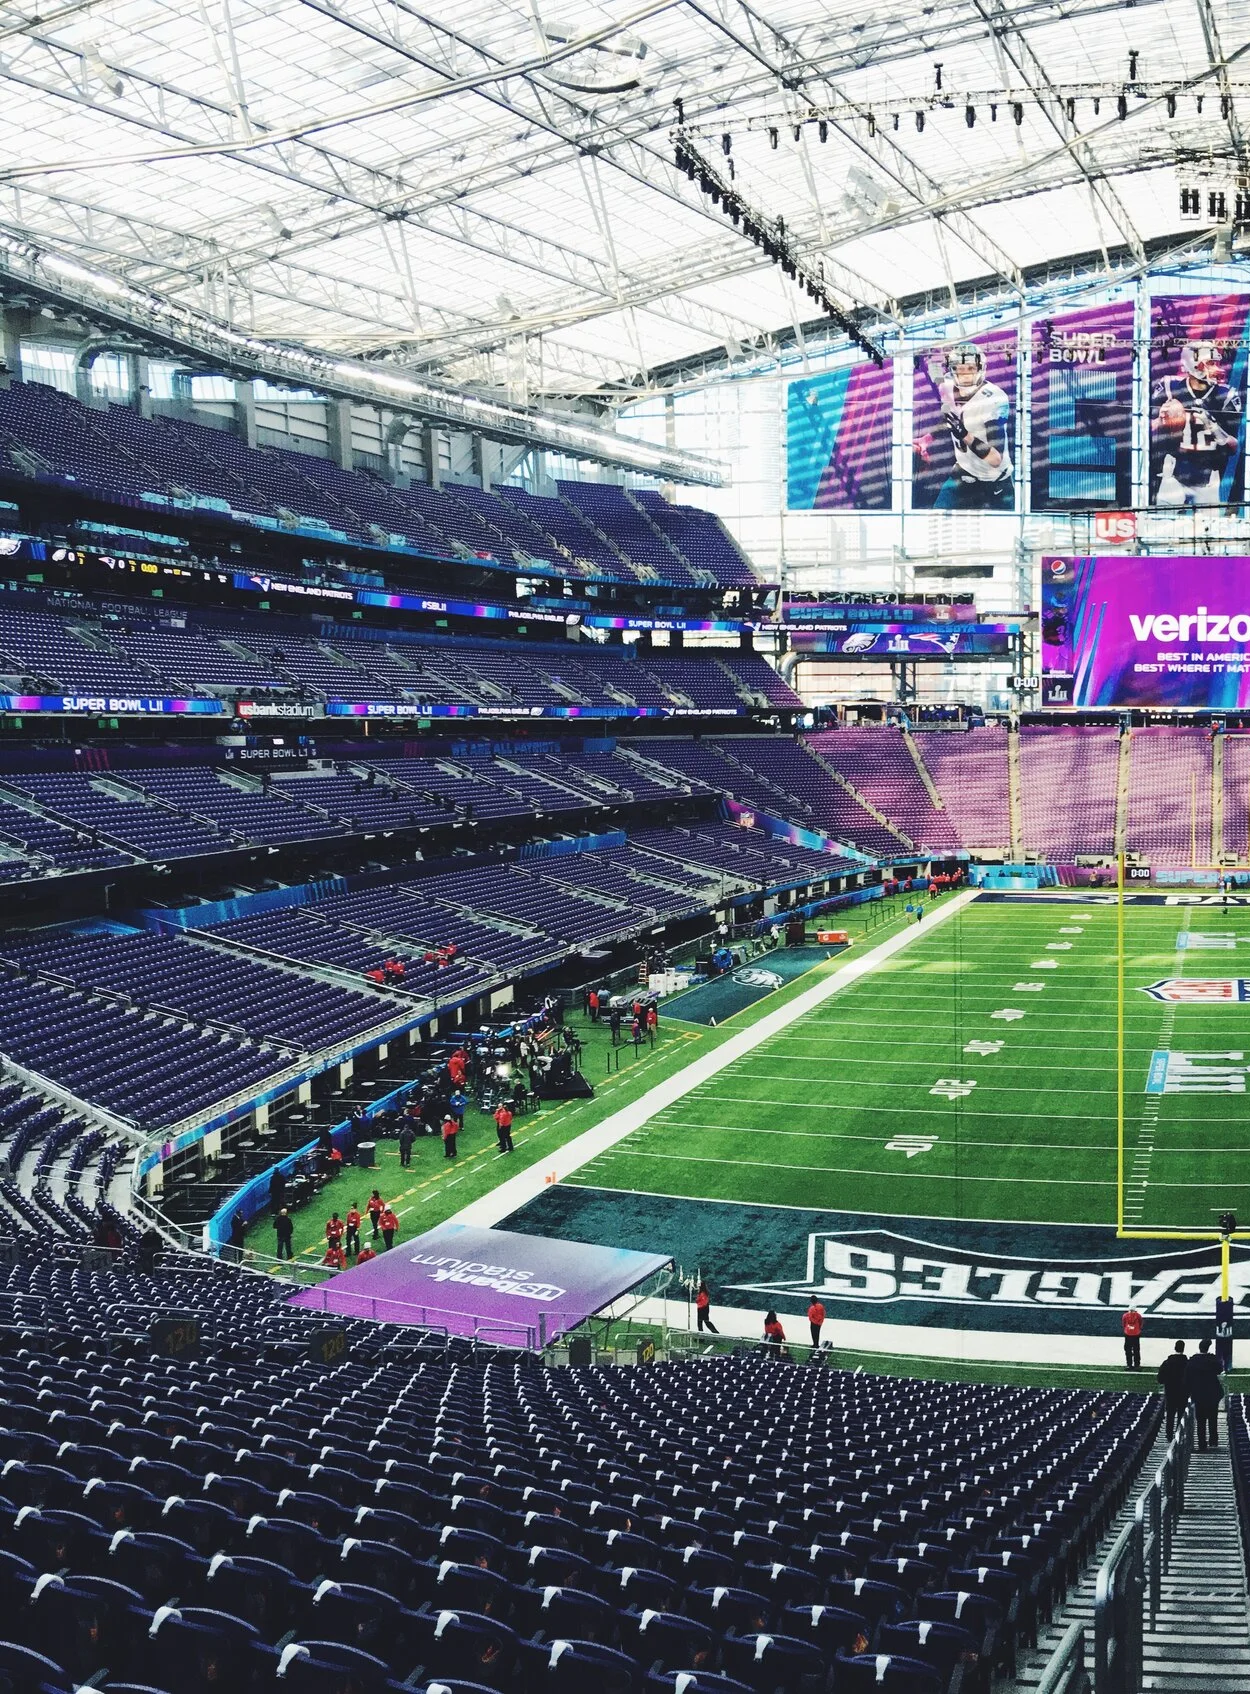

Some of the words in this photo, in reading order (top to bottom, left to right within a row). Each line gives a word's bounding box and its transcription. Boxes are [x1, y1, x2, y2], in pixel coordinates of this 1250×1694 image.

[1050, 332, 1116, 348] SUPER
[1050, 349, 1106, 364] BOWL
[1179, 411, 1217, 451] 12
[271, 582, 287, 593] NEW
[288, 585, 321, 597] ENGLAND
[322, 588, 353, 600] PATRIOTS
[47, 597, 98, 612] NATIONAL
[153, 607, 188, 620] LEAGUE
[789, 608, 844, 620] SUPER
[849, 608, 893, 620] BOWL
[628, 620, 652, 629] SUPER
[654, 621, 674, 629] BOWL
[1157, 653, 1189, 662] BEST
[1191, 653, 1203, 662] IN
[1134, 664, 1165, 673] BEST
[1167, 664, 1210, 673] WHERE
[1213, 664, 1224, 673] IT
[1013, 677, 1038, 688] 0:00
[62, 697, 106, 711] SUPER
[109, 698, 146, 711] BOWL
[149, 699, 164, 712] LII
[367, 705, 395, 714] SUPER
[397, 705, 421, 714] BOWL
[422, 705, 433, 714] LII
[240, 749, 269, 759] SUPER
[272, 749, 296, 758] BOWL
[1131, 868, 1149, 878] 0:00
[1156, 870, 1217, 883] SUPER
[410, 1254, 535, 1281] stadium
